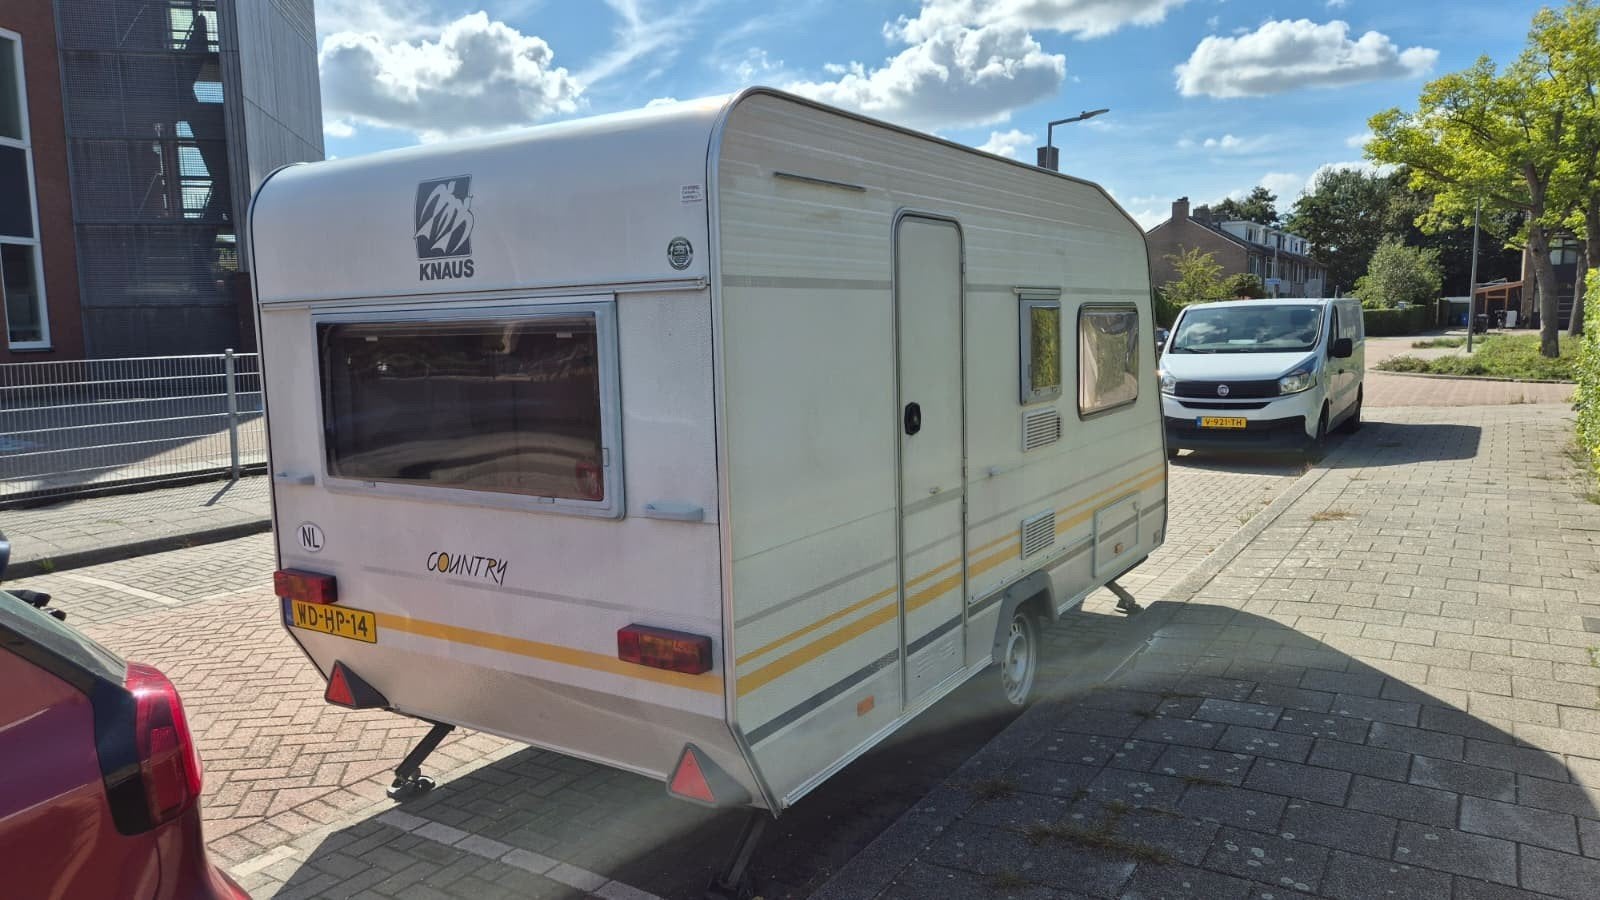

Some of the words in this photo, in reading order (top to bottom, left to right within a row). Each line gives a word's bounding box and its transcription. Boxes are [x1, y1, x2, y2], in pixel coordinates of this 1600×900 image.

[420, 259, 474, 280] KNAUS
[1205, 418, 1242, 426] V-921-TH
[302, 526, 320, 548] NL
[427, 552, 508, 586] COUNTRY
[297, 603, 368, 637] WD-HP-14
